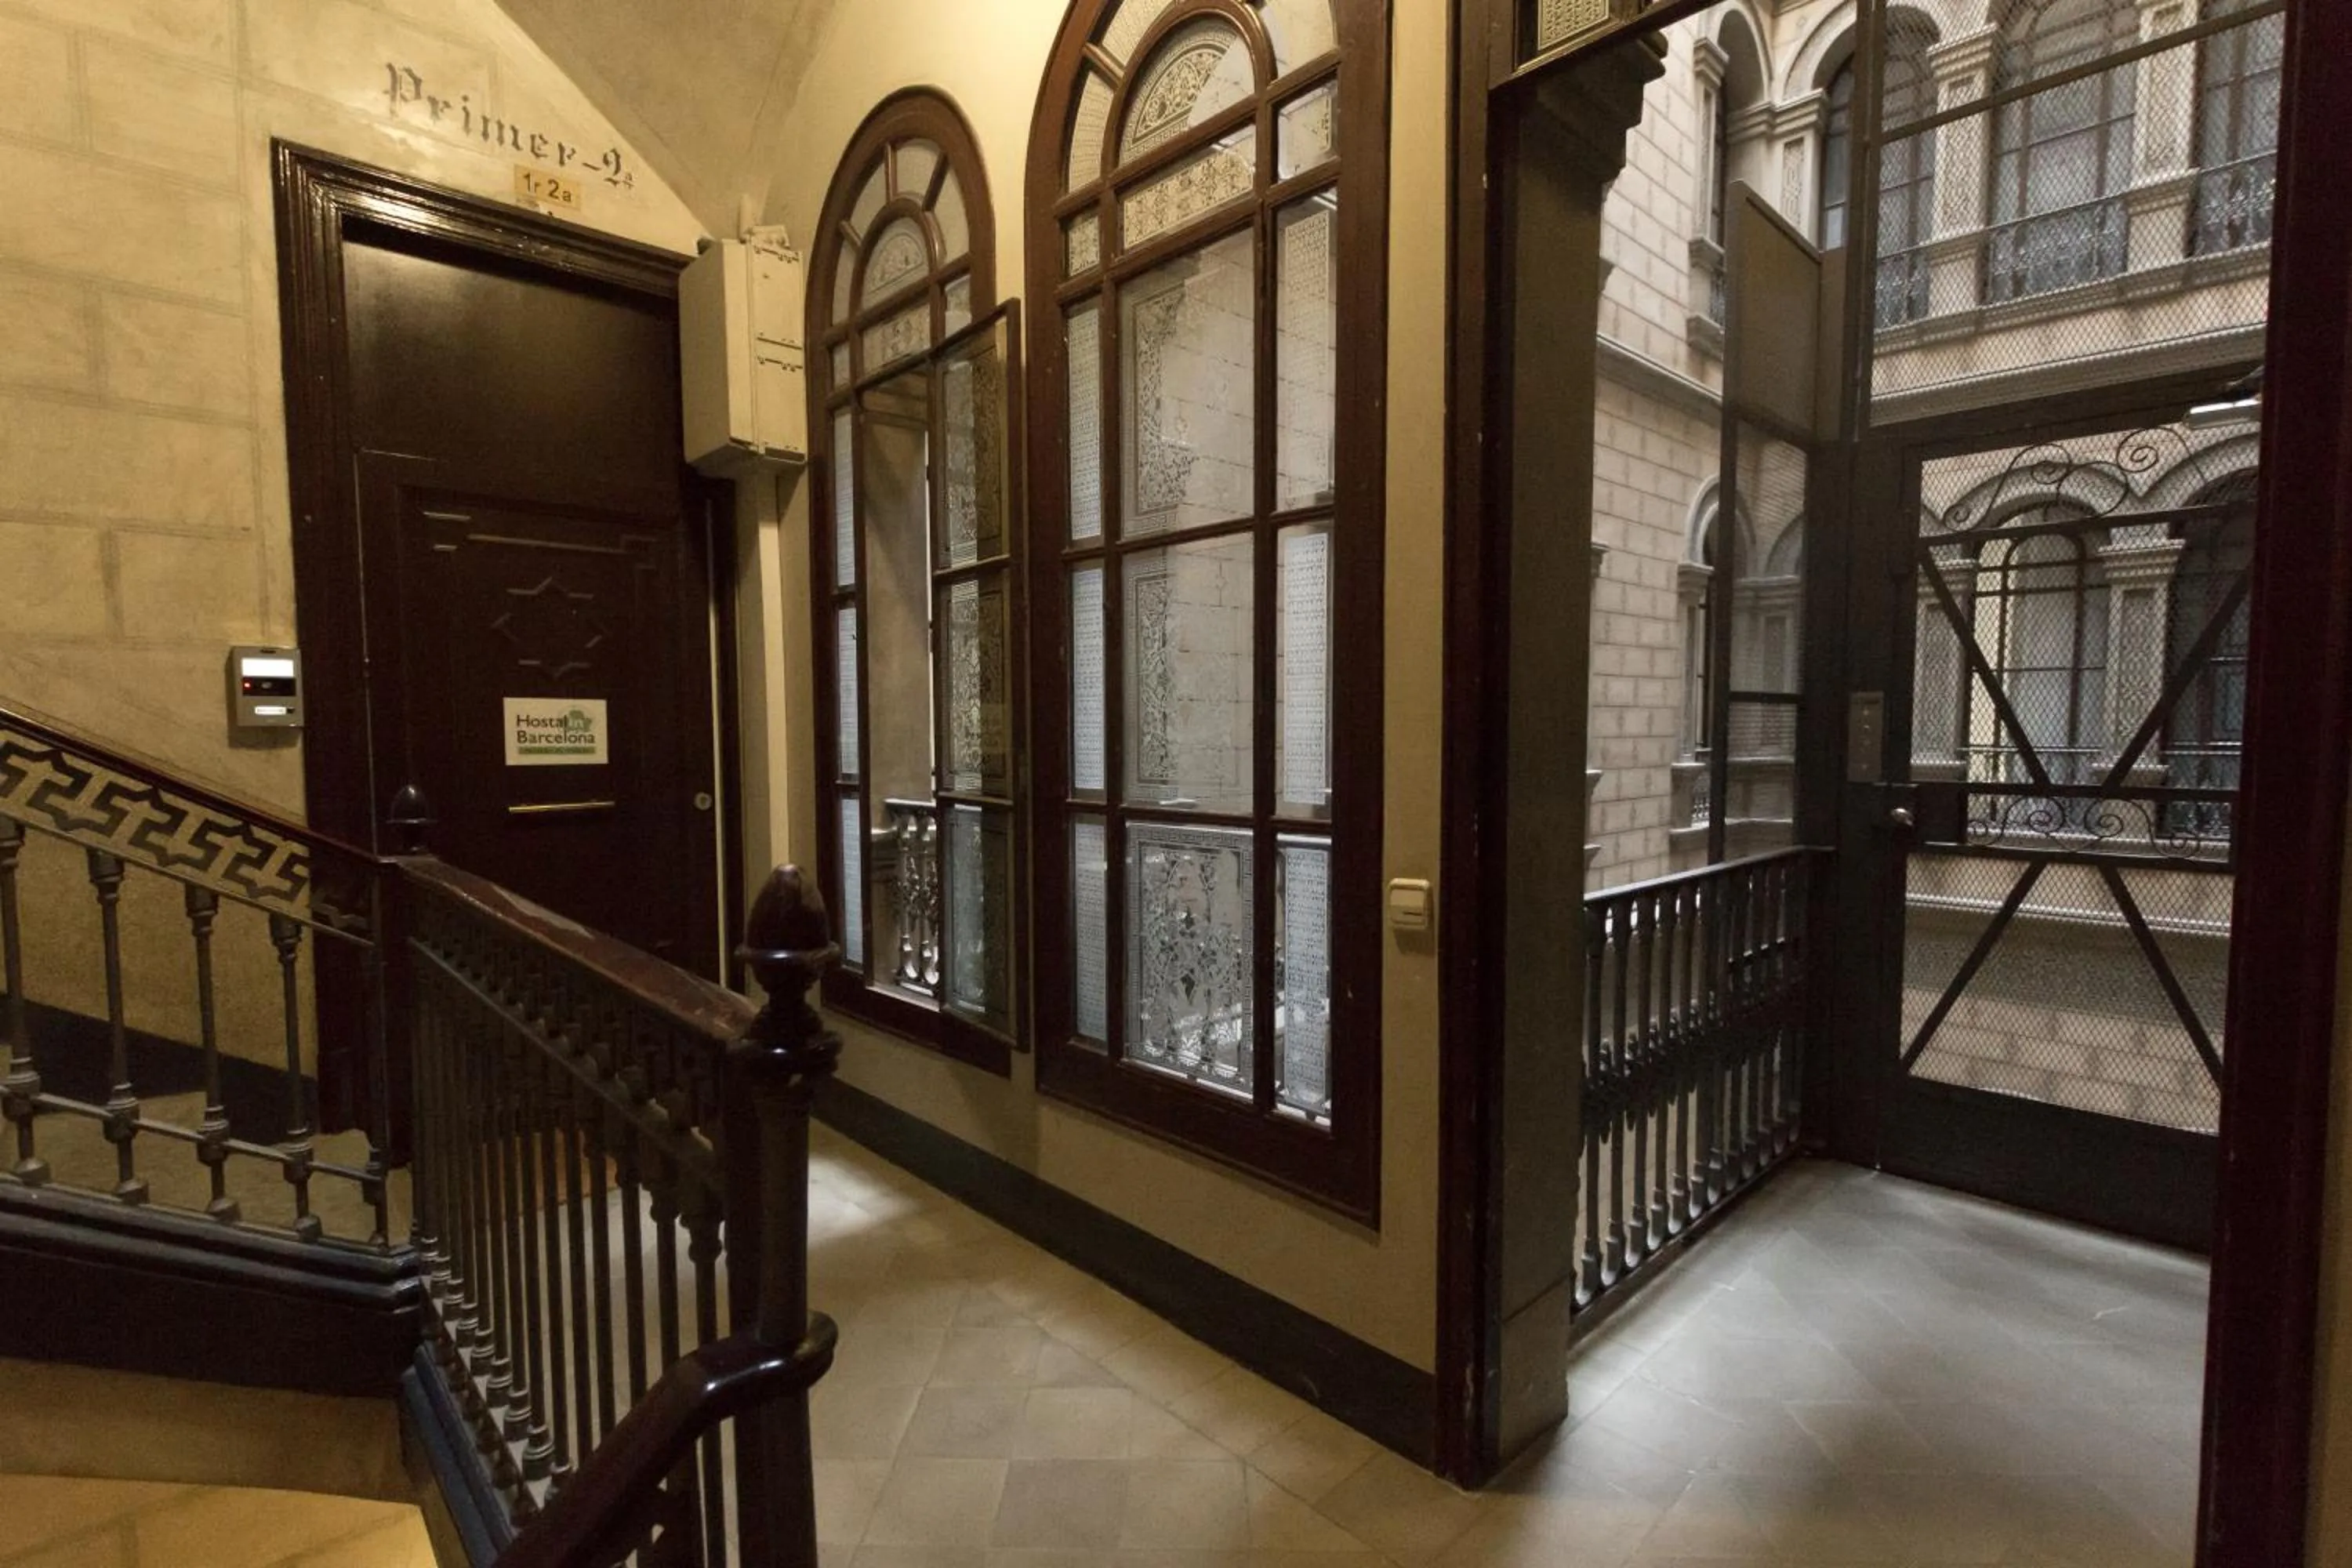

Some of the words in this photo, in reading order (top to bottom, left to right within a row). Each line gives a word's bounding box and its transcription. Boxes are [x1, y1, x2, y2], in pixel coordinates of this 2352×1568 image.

[523, 172, 541, 194] 1r
[546, 178, 572, 203] 2a
[517, 730, 596, 744] Barcelona
